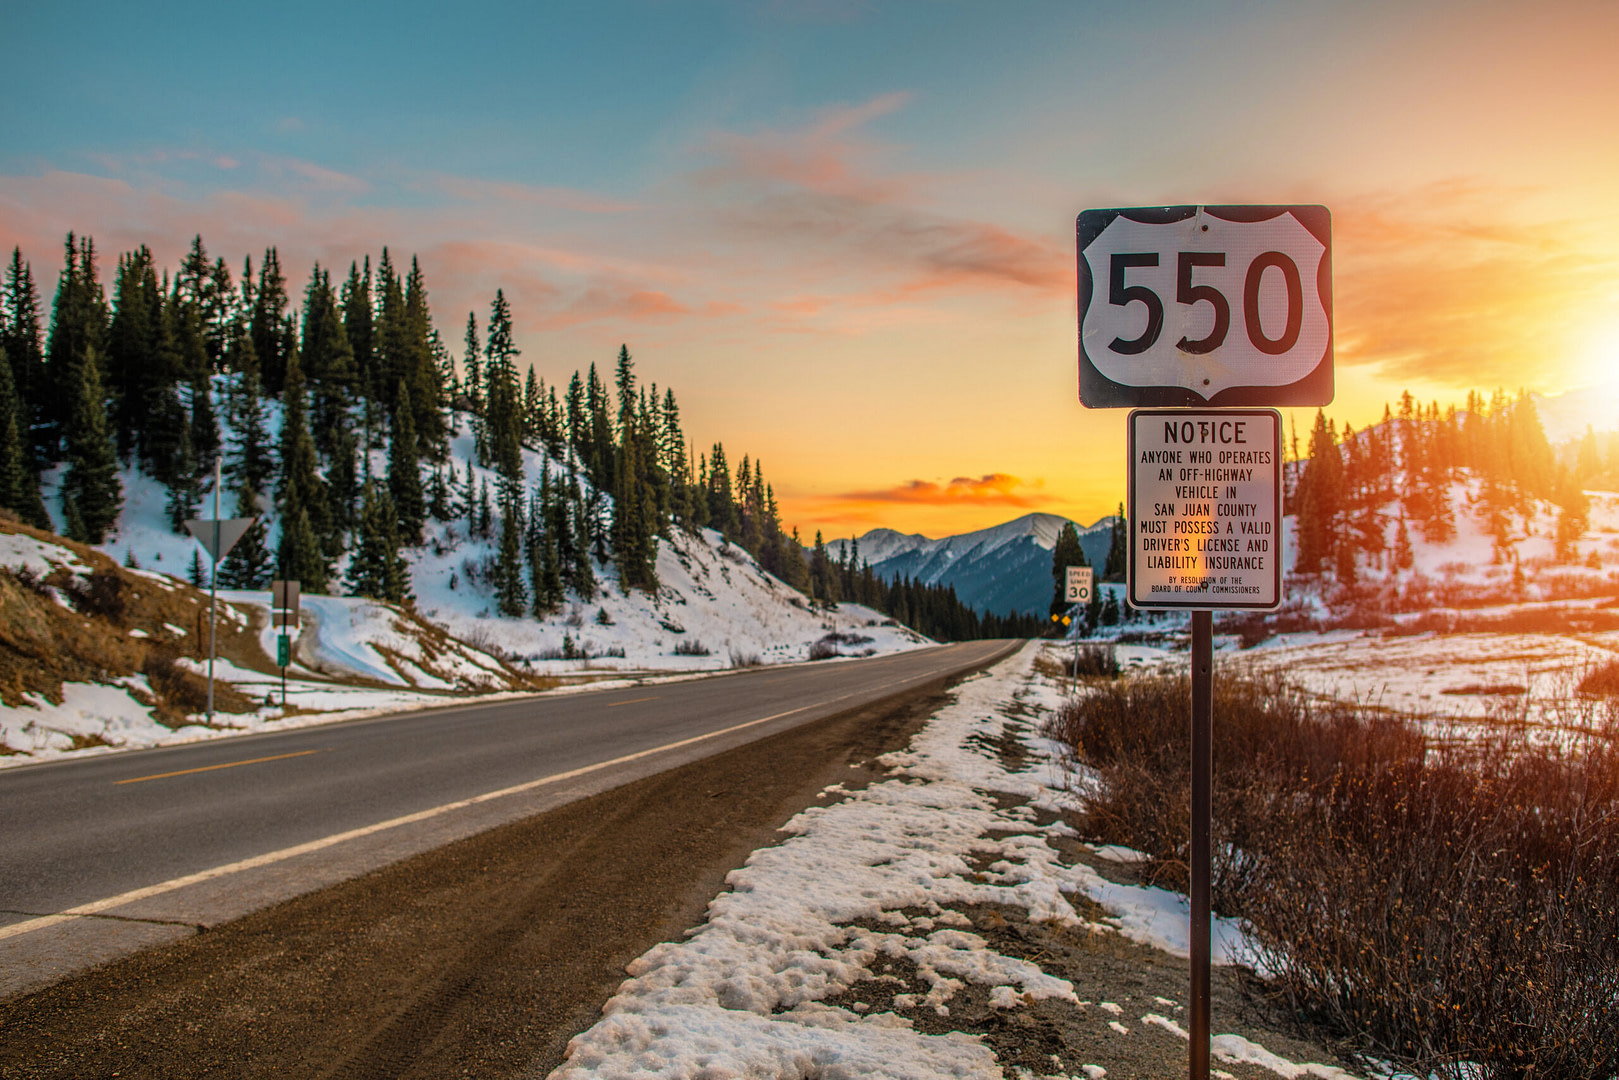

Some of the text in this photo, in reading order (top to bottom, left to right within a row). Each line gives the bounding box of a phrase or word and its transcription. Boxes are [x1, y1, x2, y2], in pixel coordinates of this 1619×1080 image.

[1107, 250, 1303, 355] 550
[1164, 421, 1246, 444] NOTICE
[1141, 451, 1271, 464] ANYONE WHO OPERATES
[1158, 468, 1253, 481] AN OFF-HIGHWAY
[1175, 486, 1237, 499] VEHICLE IN
[1154, 503, 1257, 517] SAN JUAN COUNTY
[1140, 521, 1271, 535] MUST POSSESS A VALID
[1143, 538, 1268, 552] DRIVER'S LICENSE AND
[1147, 556, 1264, 570] LIABILITY INSURANCE
[1168, 576, 1177, 584] BY
[1219, 576, 1227, 585] OF
[1231, 577, 1242, 585] THE
[1069, 586, 1088, 599] 30
[1151, 585, 1171, 593] BOARD
[1174, 585, 1182, 593] OF
[1212, 585, 1260, 594] COMMISSIONERS
